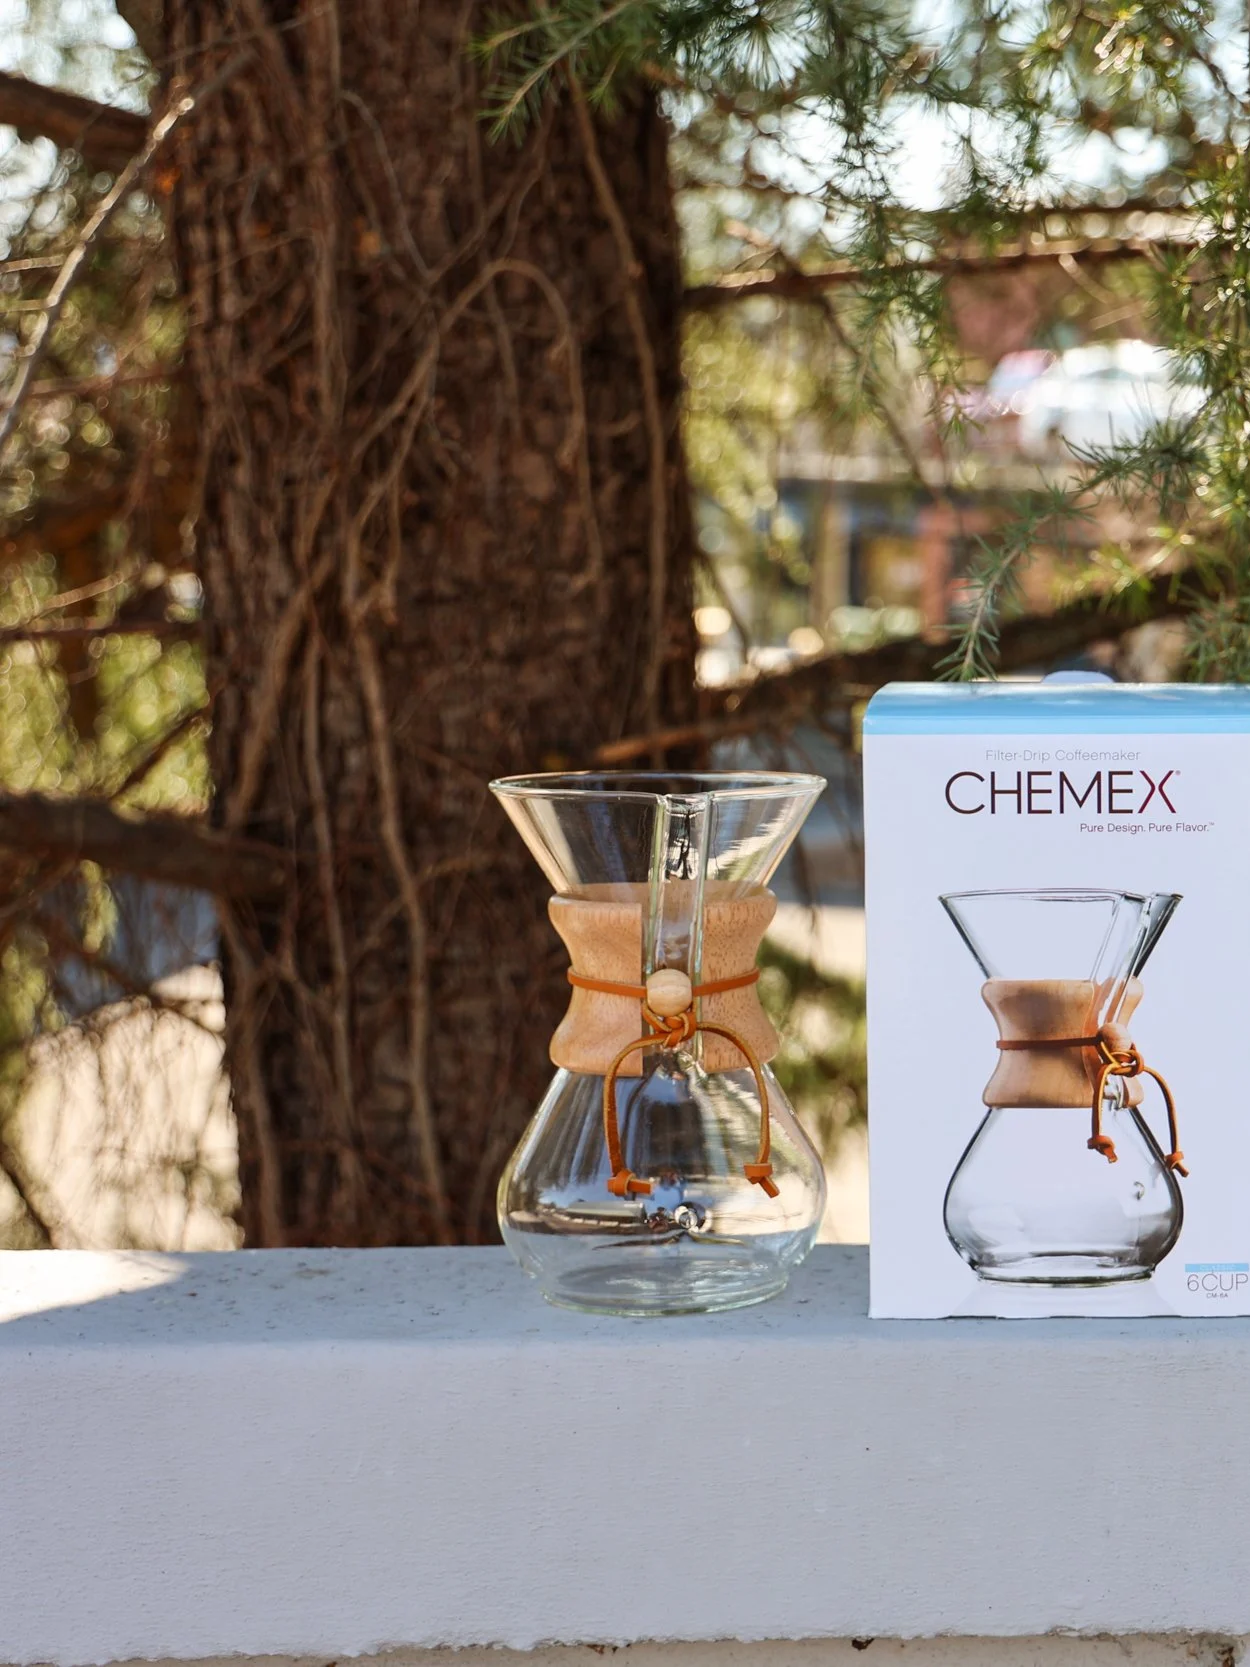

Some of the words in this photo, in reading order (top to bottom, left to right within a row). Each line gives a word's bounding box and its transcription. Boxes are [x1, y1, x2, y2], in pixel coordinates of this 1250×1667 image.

[985, 749, 1051, 763] Filter-Drip
[1055, 749, 1141, 761] Coffeemaker
[1080, 823, 1104, 832] Pure
[1107, 822, 1146, 835] Design.
[1148, 822, 1173, 832] Pure
